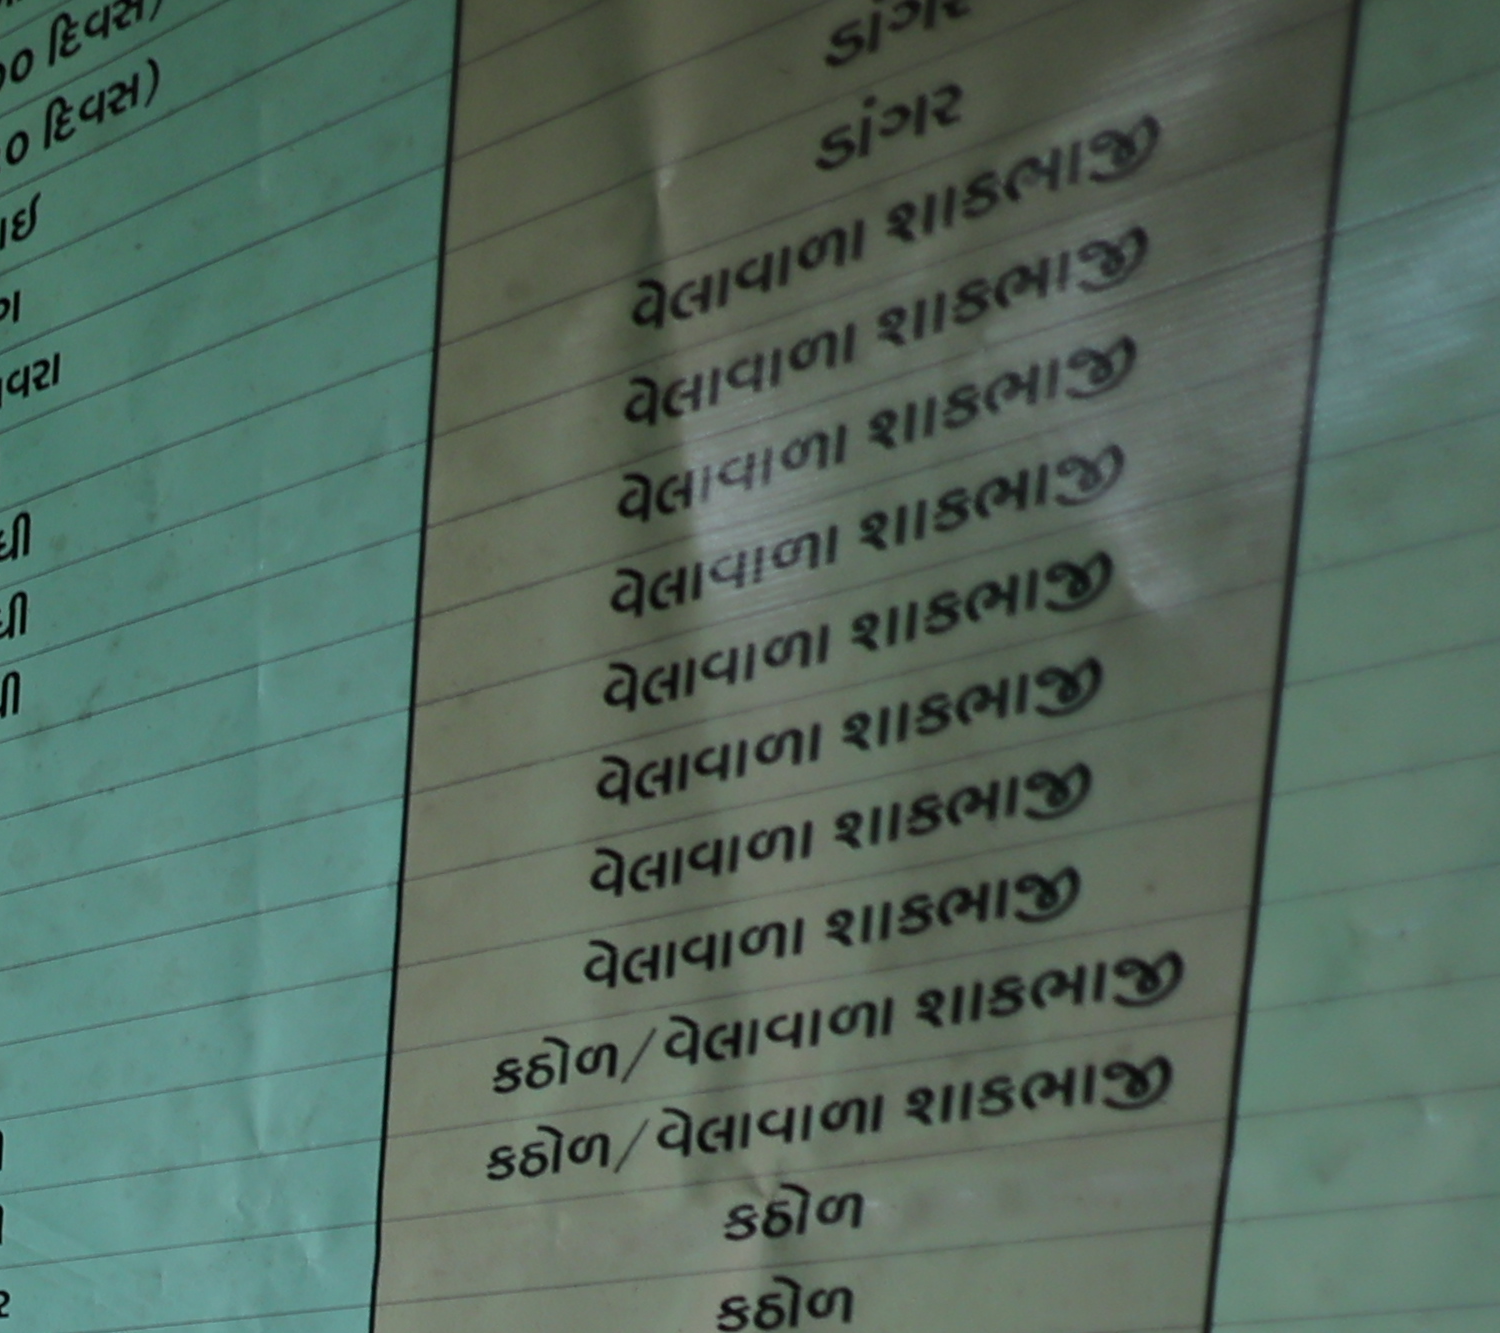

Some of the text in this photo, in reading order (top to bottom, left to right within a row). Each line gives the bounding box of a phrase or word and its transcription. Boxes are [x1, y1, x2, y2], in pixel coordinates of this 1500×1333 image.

[44, 58, 159, 149] દિવસ)
[816, 84, 962, 170] ડાંગર
[630, 116, 1160, 330] વેલાવાળા શાકભાજી
[624, 227, 1148, 427] વેલાવાળા શાકભાજી
[617, 336, 1137, 523] વેલાવાળા શાકભાજી
[610, 445, 1124, 618] વેલાવાળા શાકભાજી
[603, 551, 1114, 712] વેલાવાળા શાકભાજી
[596, 657, 1103, 805] વેલાવાળા શાકભાજી
[590, 762, 1092, 897] વેલાવાળા શાકભાજી
[584, 866, 1081, 988] વેલાવાળા શાકભાજી
[917, 951, 1184, 1027] શાકભાજી
[906, 1055, 1173, 1125] શાકભાજી
[725, 1182, 863, 1241] કઠોળ
[717, 1275, 853, 1332] કઠોળ
